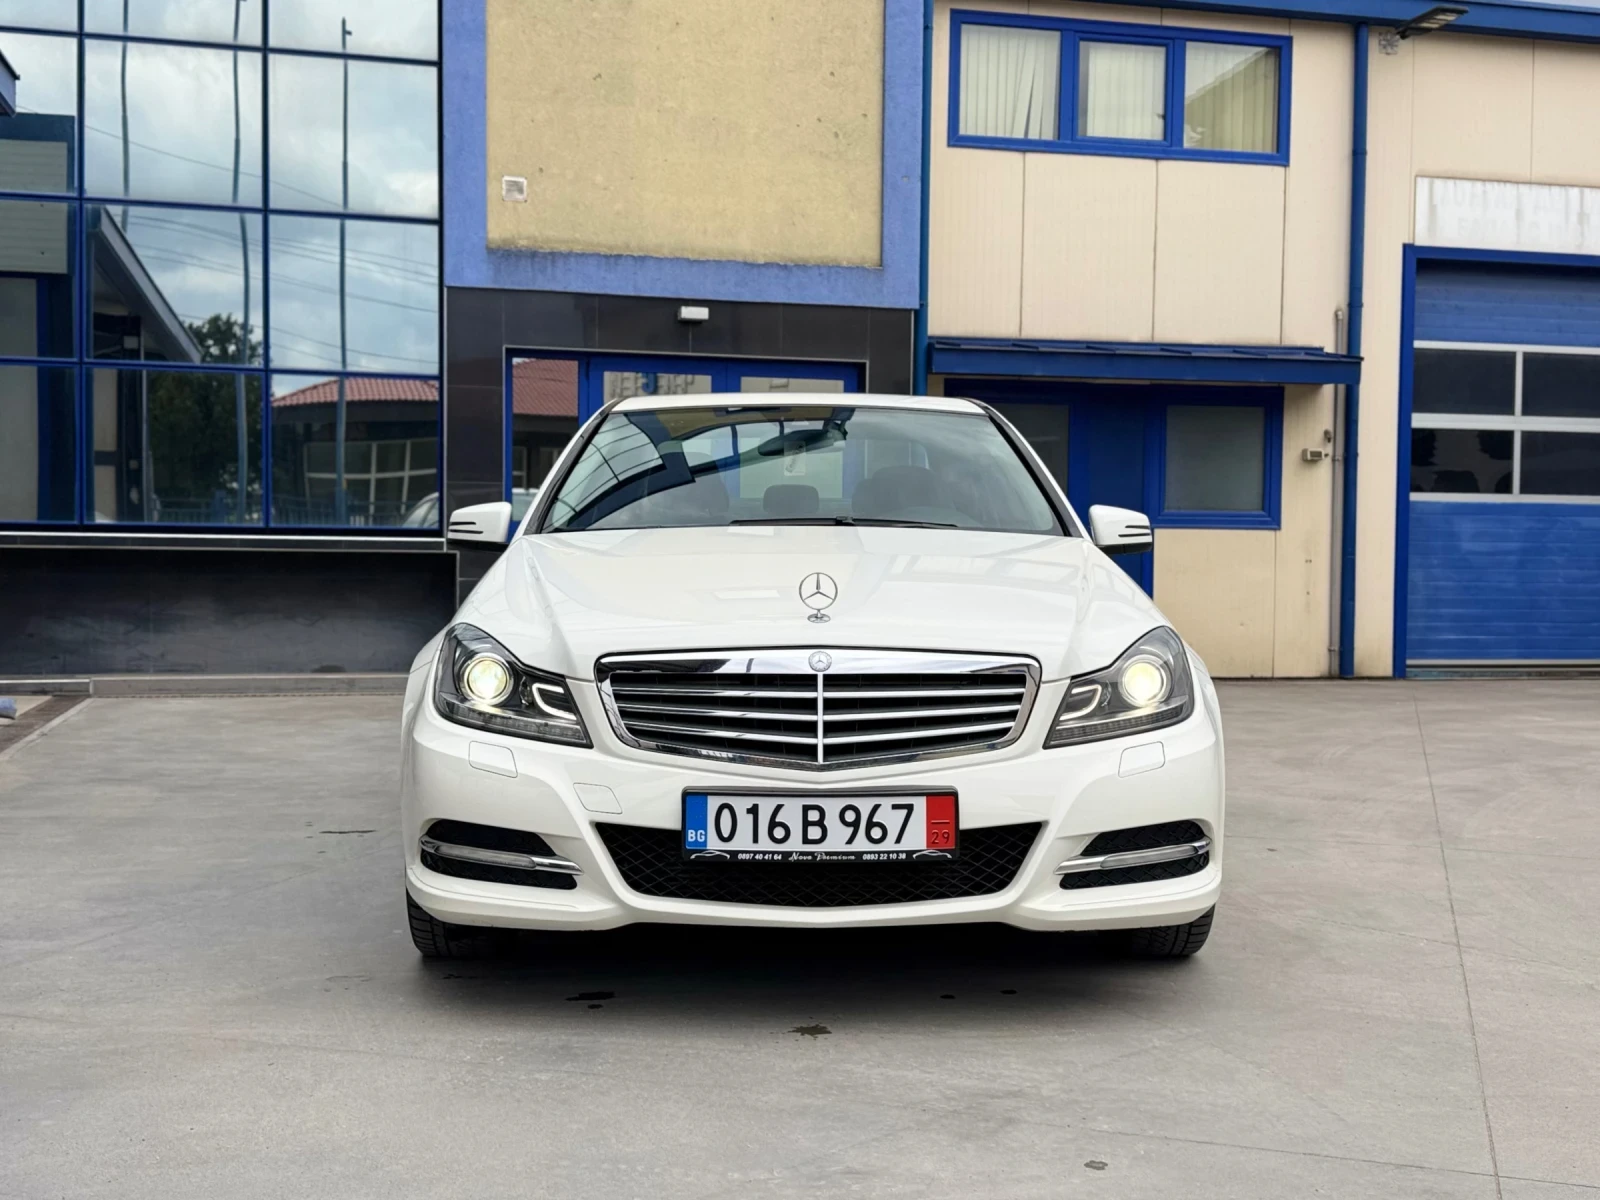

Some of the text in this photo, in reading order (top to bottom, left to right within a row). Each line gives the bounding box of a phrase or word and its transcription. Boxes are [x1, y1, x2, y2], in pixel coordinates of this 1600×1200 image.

[714, 802, 915, 845] 016 B 967
[688, 829, 705, 842] BG
[931, 830, 950, 844] 29
[814, 852, 856, 861] Premium
